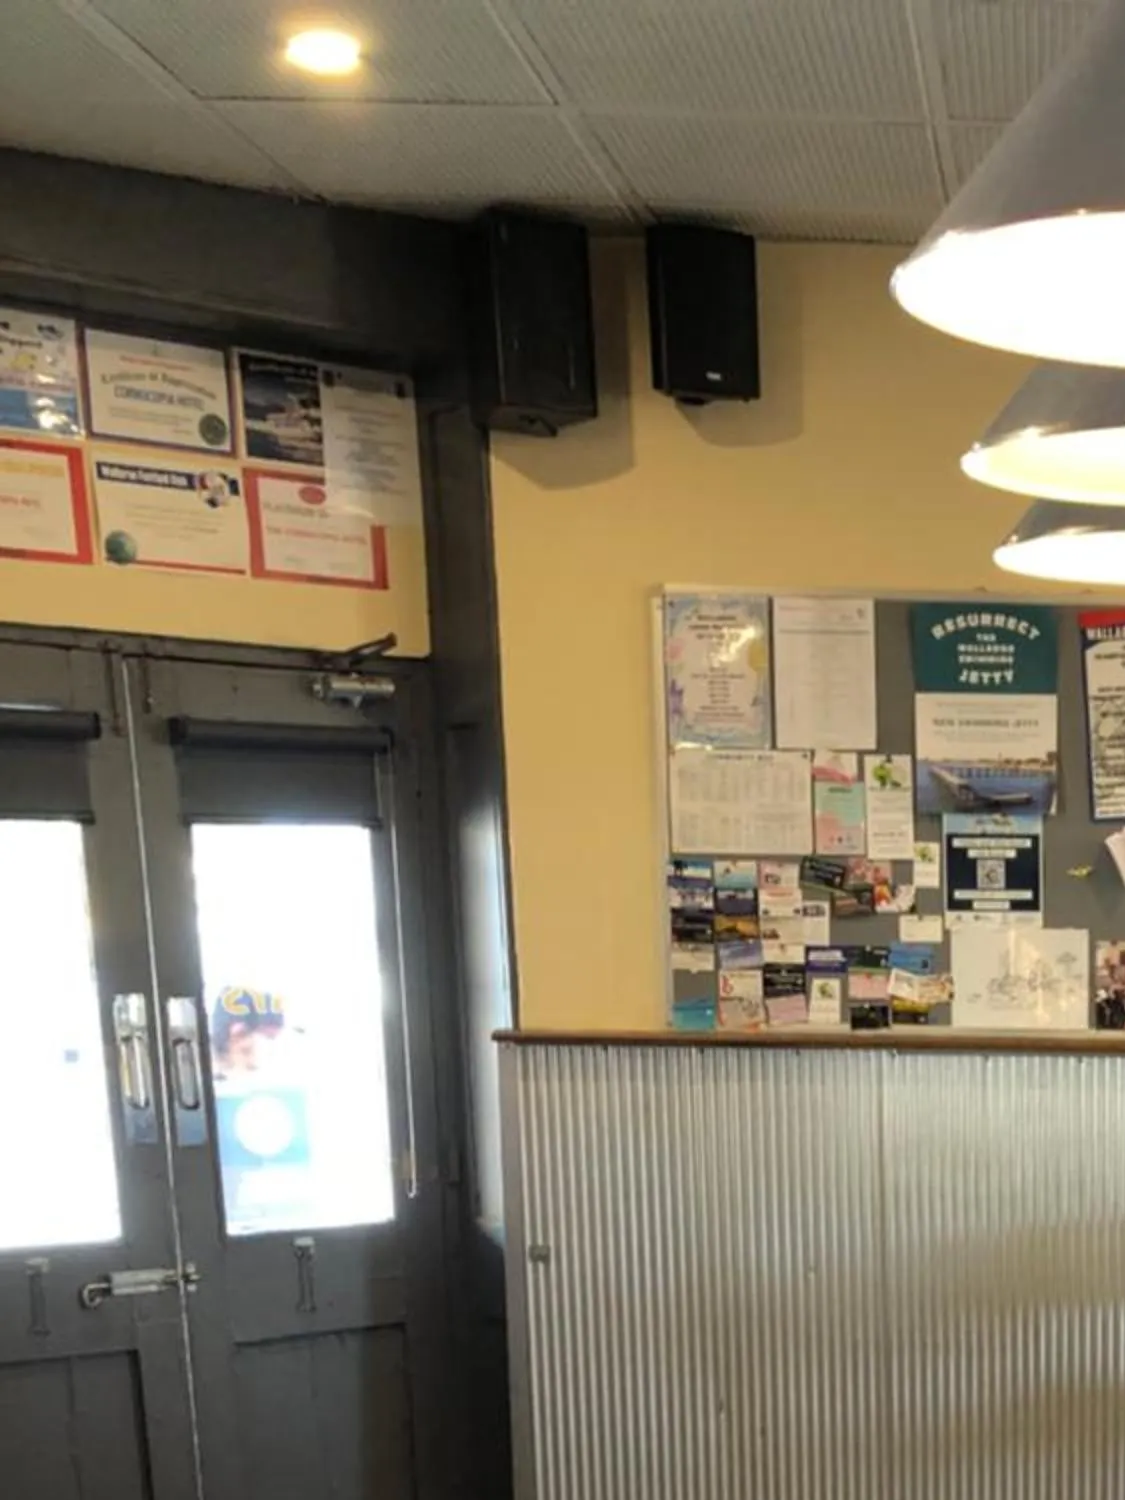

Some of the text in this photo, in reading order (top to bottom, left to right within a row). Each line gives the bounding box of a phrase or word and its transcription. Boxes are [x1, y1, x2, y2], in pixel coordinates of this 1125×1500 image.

[930, 612, 1041, 640] RESURRECT
[976, 633, 997, 642] THE
[958, 669, 1015, 686] JETTY
